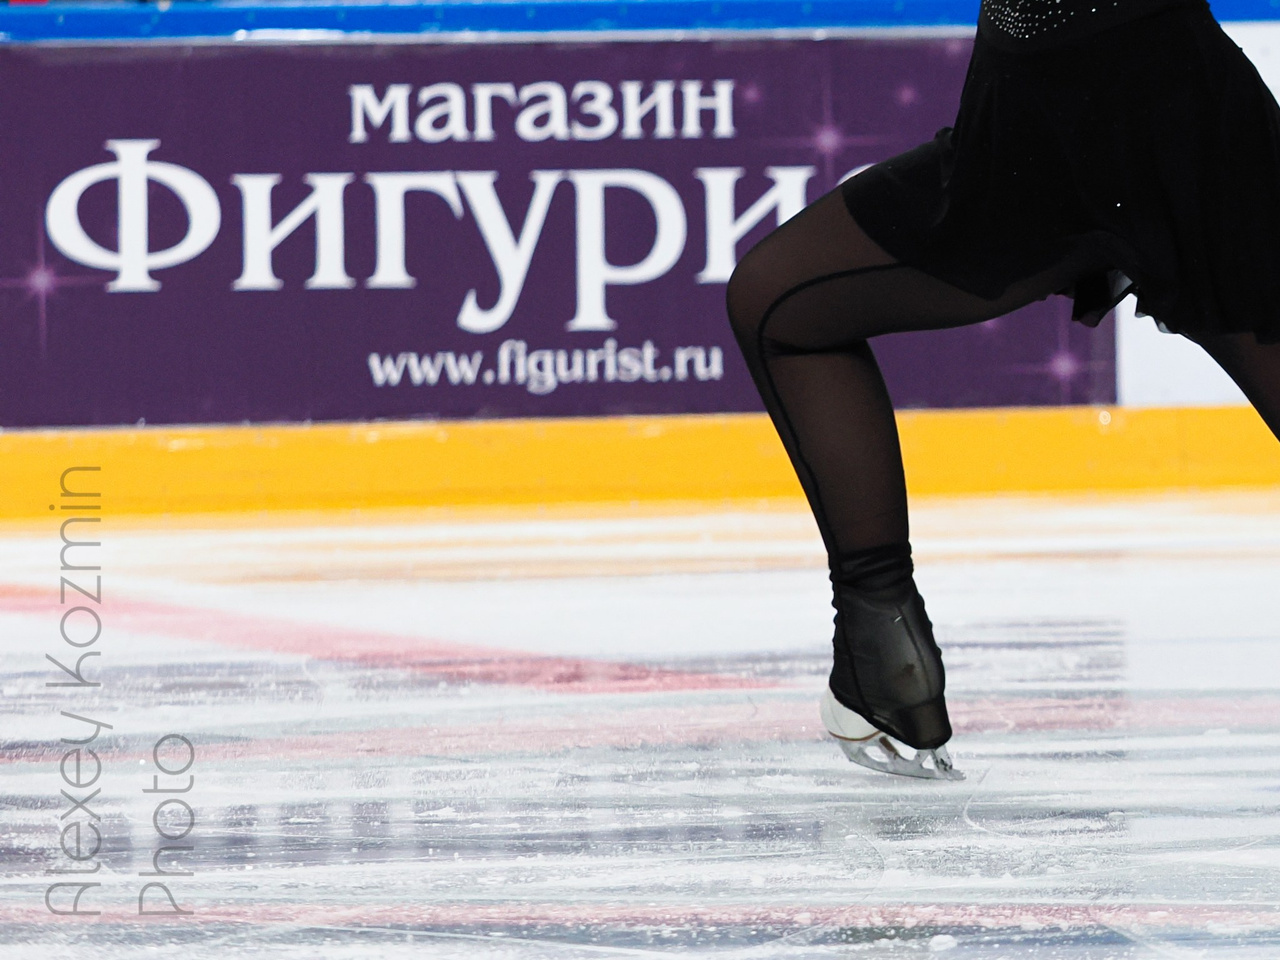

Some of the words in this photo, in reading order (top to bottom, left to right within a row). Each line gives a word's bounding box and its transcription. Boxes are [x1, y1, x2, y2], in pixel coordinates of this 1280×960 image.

[349, 79, 736, 144] магазин
[44, 138, 876, 332] Фигури
[368, 338, 724, 394] www.figurist.ru
